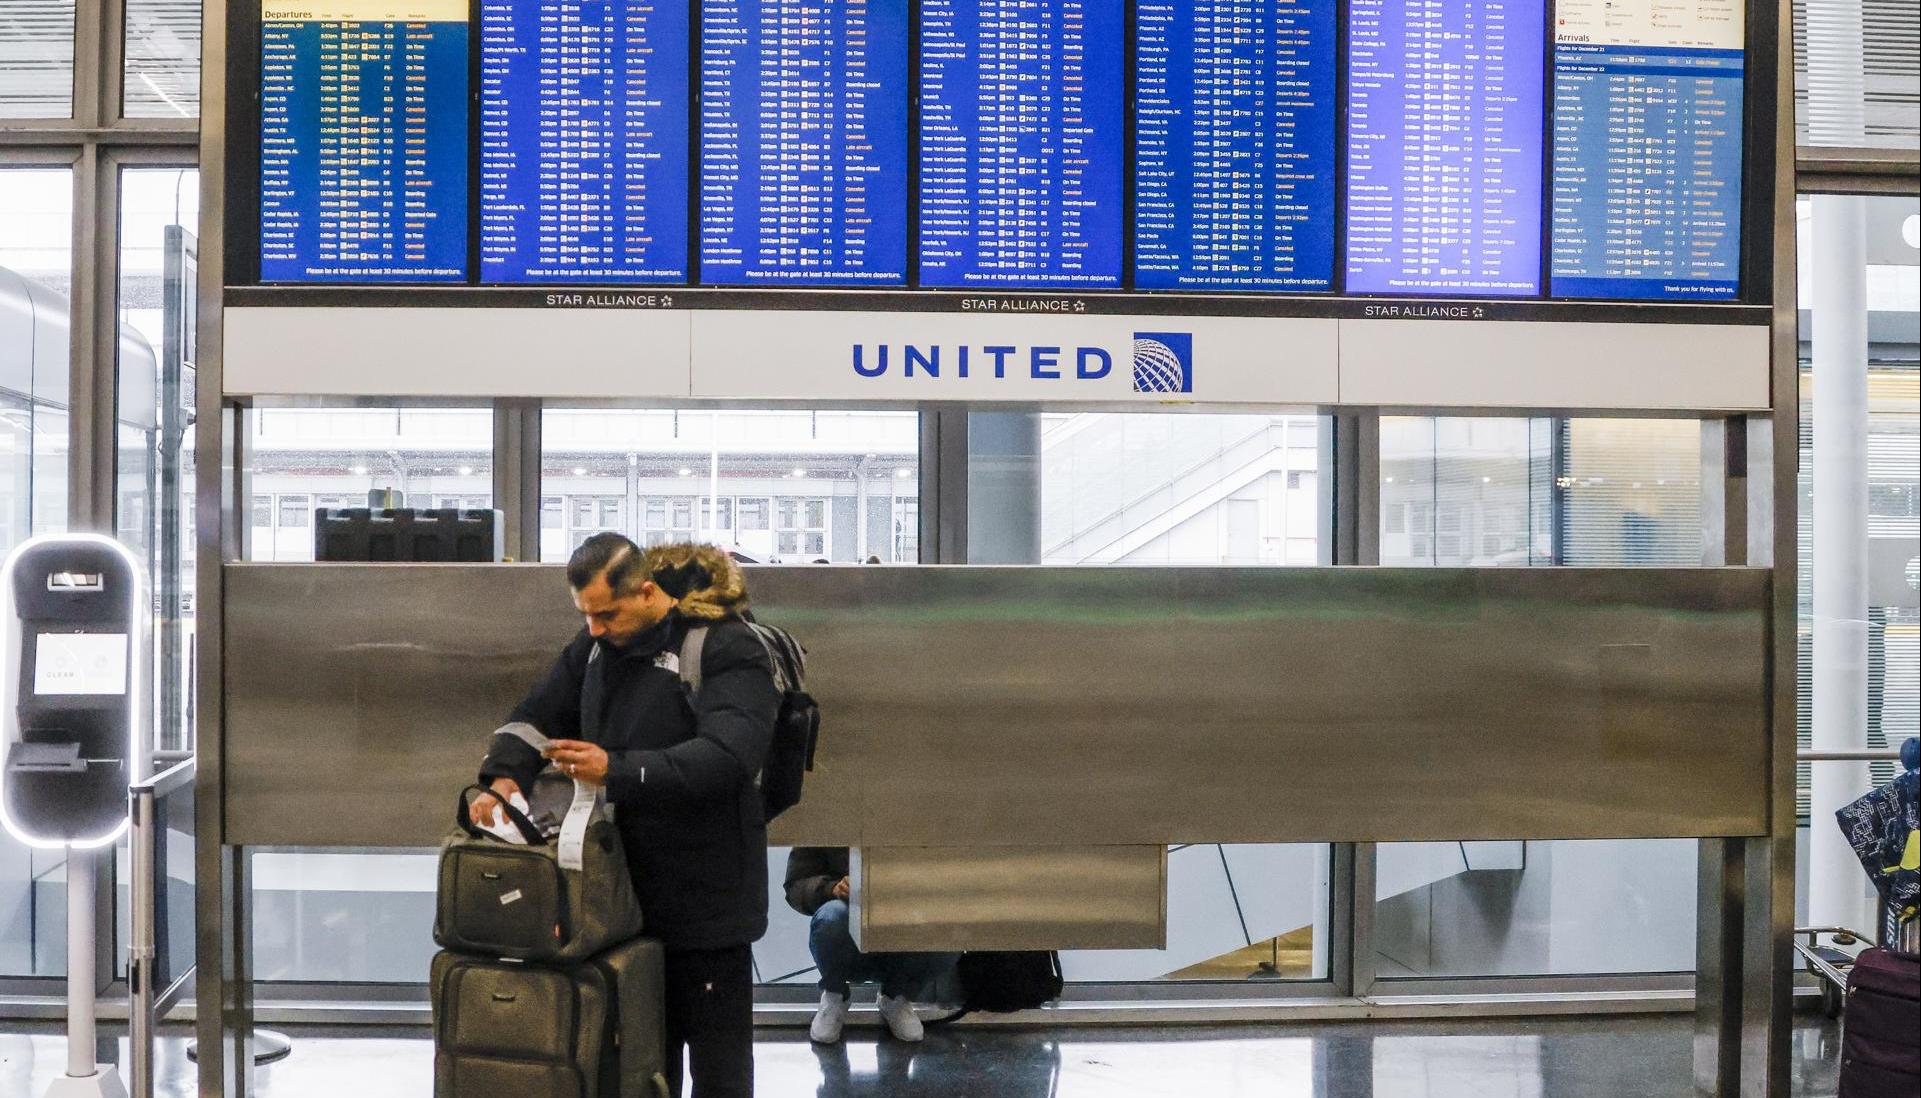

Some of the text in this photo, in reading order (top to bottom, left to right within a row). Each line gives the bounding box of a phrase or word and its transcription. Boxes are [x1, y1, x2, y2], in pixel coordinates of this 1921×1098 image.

[265, 11, 312, 19] Departures
[1558, 34, 1590, 42] Arrivals
[547, 295, 656, 306] STAR ALLIANCE
[962, 300, 1069, 310] STAR ALLIANCE
[1365, 306, 1468, 316] STAR ALLIANCE
[853, 344, 1112, 380] UNITED
